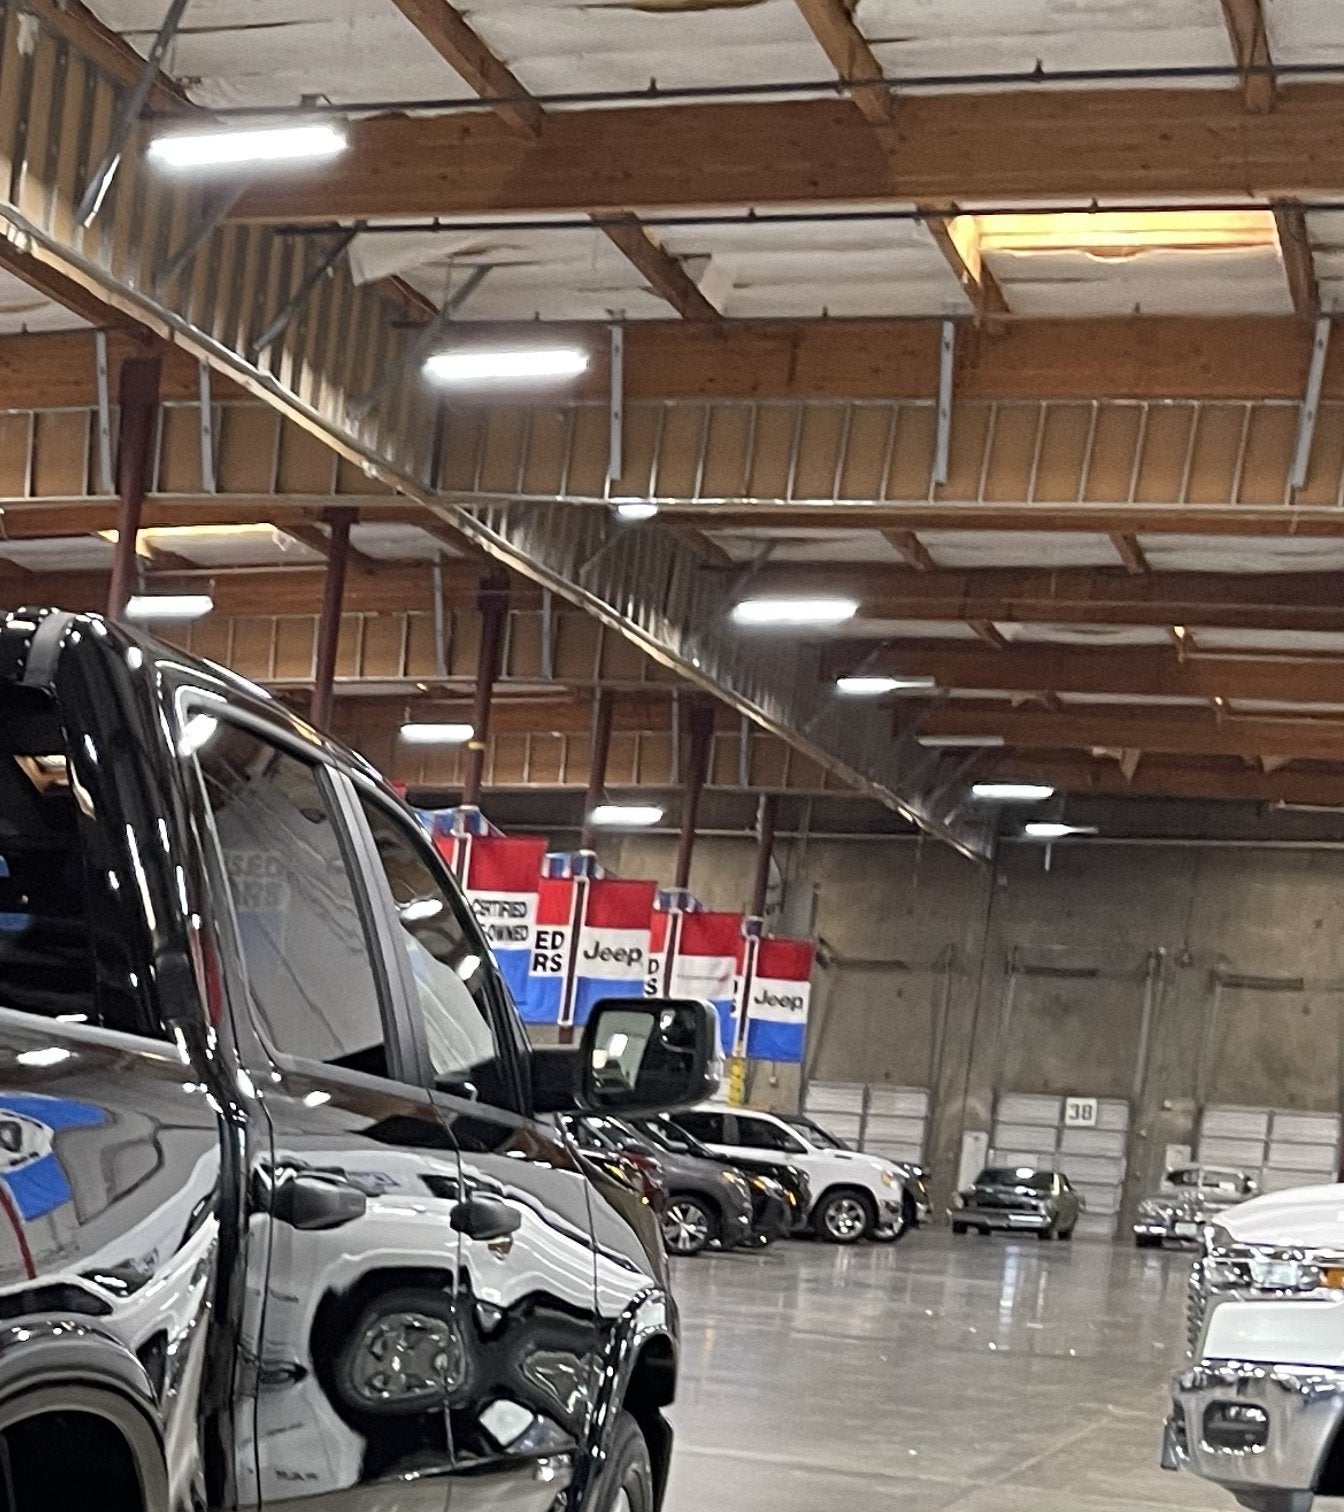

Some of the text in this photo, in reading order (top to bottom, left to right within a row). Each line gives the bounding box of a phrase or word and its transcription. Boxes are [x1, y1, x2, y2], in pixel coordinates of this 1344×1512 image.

[534, 930, 566, 950] ED
[532, 952, 563, 972] RS
[583, 940, 644, 967] Jeep
[754, 989, 804, 1012] Jeep
